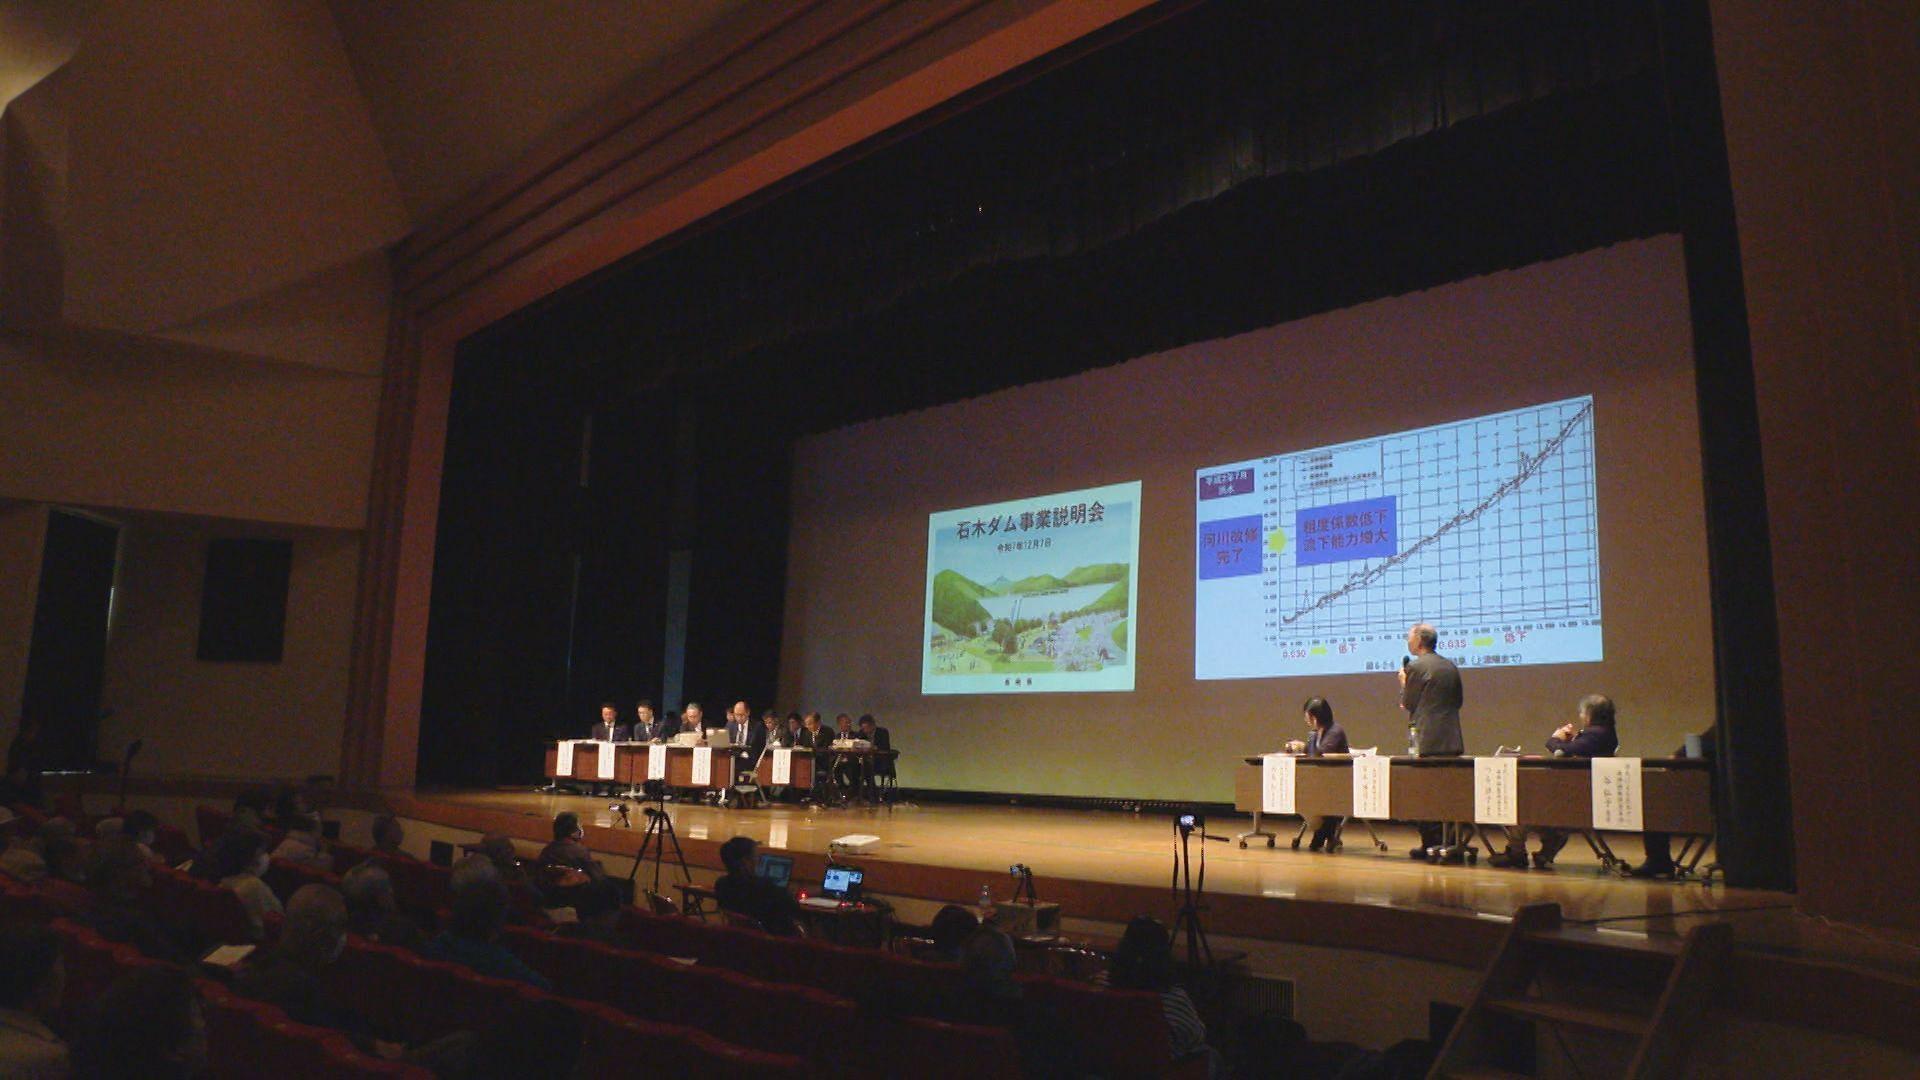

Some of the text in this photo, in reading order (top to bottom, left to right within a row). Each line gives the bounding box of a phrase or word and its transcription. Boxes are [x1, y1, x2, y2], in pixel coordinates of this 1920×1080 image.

[956, 501, 1105, 540] 石木ダム事業説明会
[1303, 509, 1388, 534] 粗度係数低下
[1203, 527, 1259, 548] 河川改修
[1303, 528, 1388, 552] 流下能力増大
[1216, 546, 1243, 565] 完了
